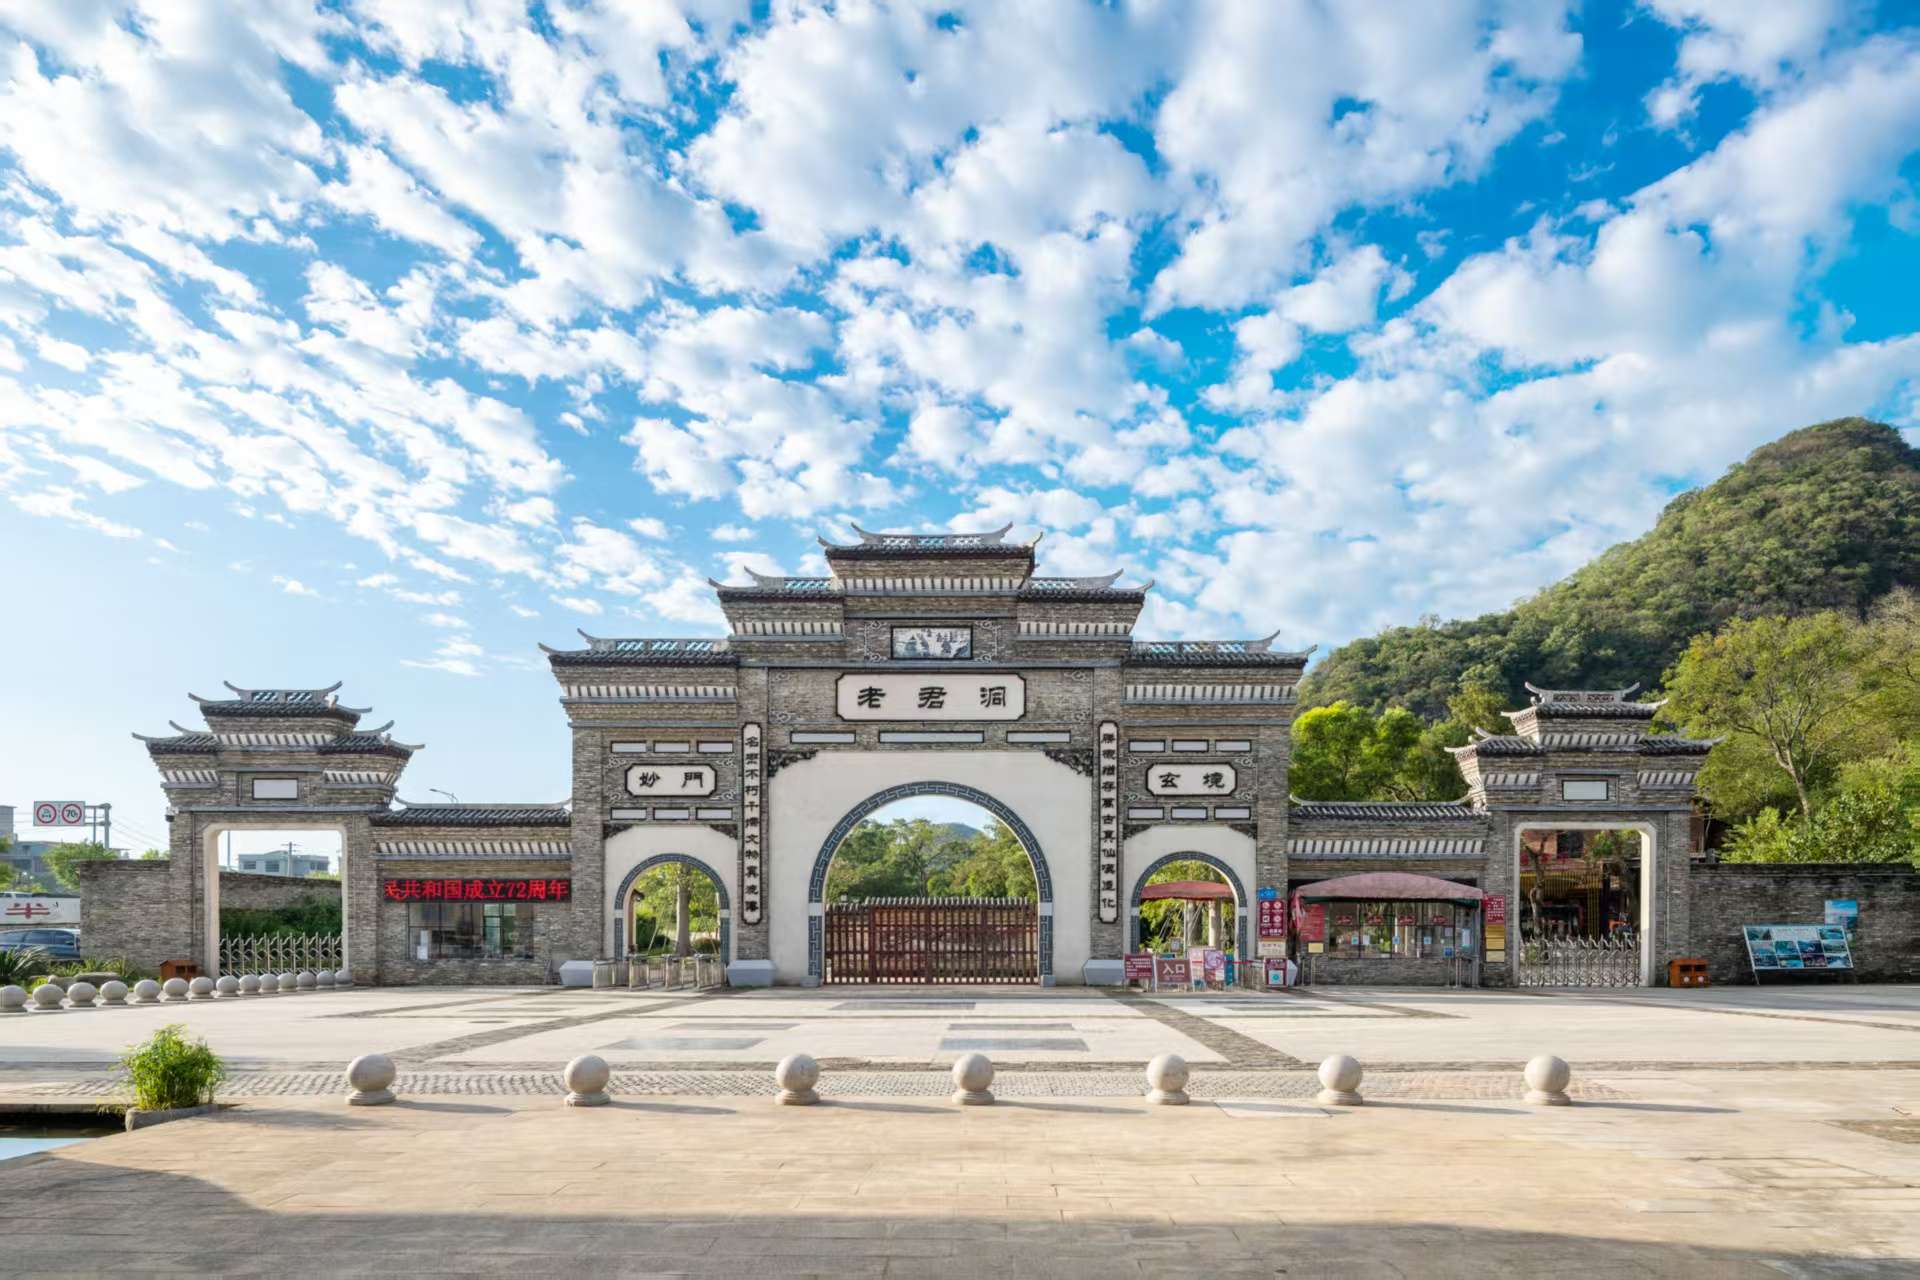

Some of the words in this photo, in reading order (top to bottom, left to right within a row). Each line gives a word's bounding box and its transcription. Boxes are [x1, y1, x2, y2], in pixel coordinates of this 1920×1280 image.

[857, 686, 1006, 709] 老君洞
[639, 771, 704, 788] 妙門
[1158, 771, 1225, 788] 玄境
[1163, 963, 1185, 975] 入口
